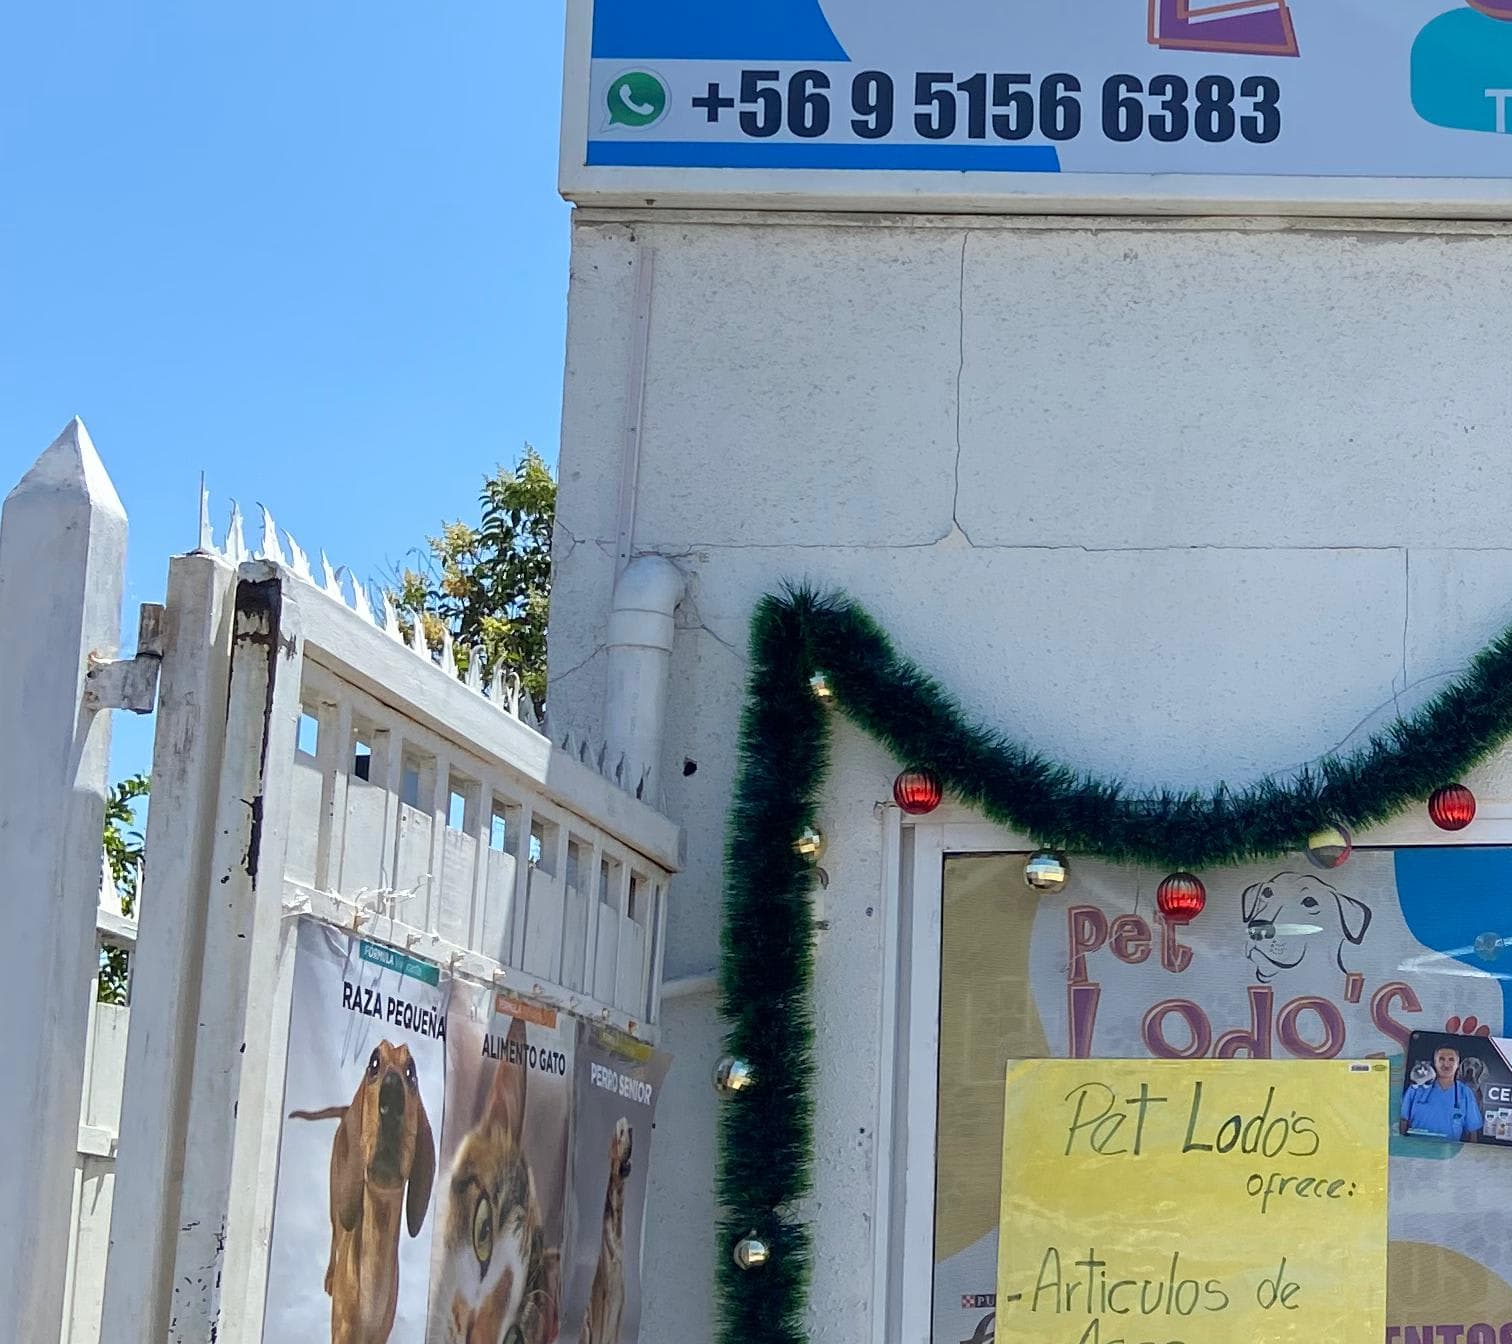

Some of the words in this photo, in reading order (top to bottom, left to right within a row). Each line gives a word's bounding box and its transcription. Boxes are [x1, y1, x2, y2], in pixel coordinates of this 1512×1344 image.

[691, 69, 831, 139] +56
[850, 71, 895, 140] 9
[914, 72, 1082, 141] 5156
[1101, 75, 1282, 144] 6383
[342, 981, 382, 1020] RAZA
[387, 996, 446, 1042] PEQUEÑA
[482, 1033, 537, 1069] ALIMENTO
[539, 1048, 566, 1076] GATO
[591, 1063, 618, 1093] PERRO
[618, 1074, 652, 1105] SENIOR
[1064, 1082, 1168, 1157] Pet
[1256, 1256, 1301, 1310] de
